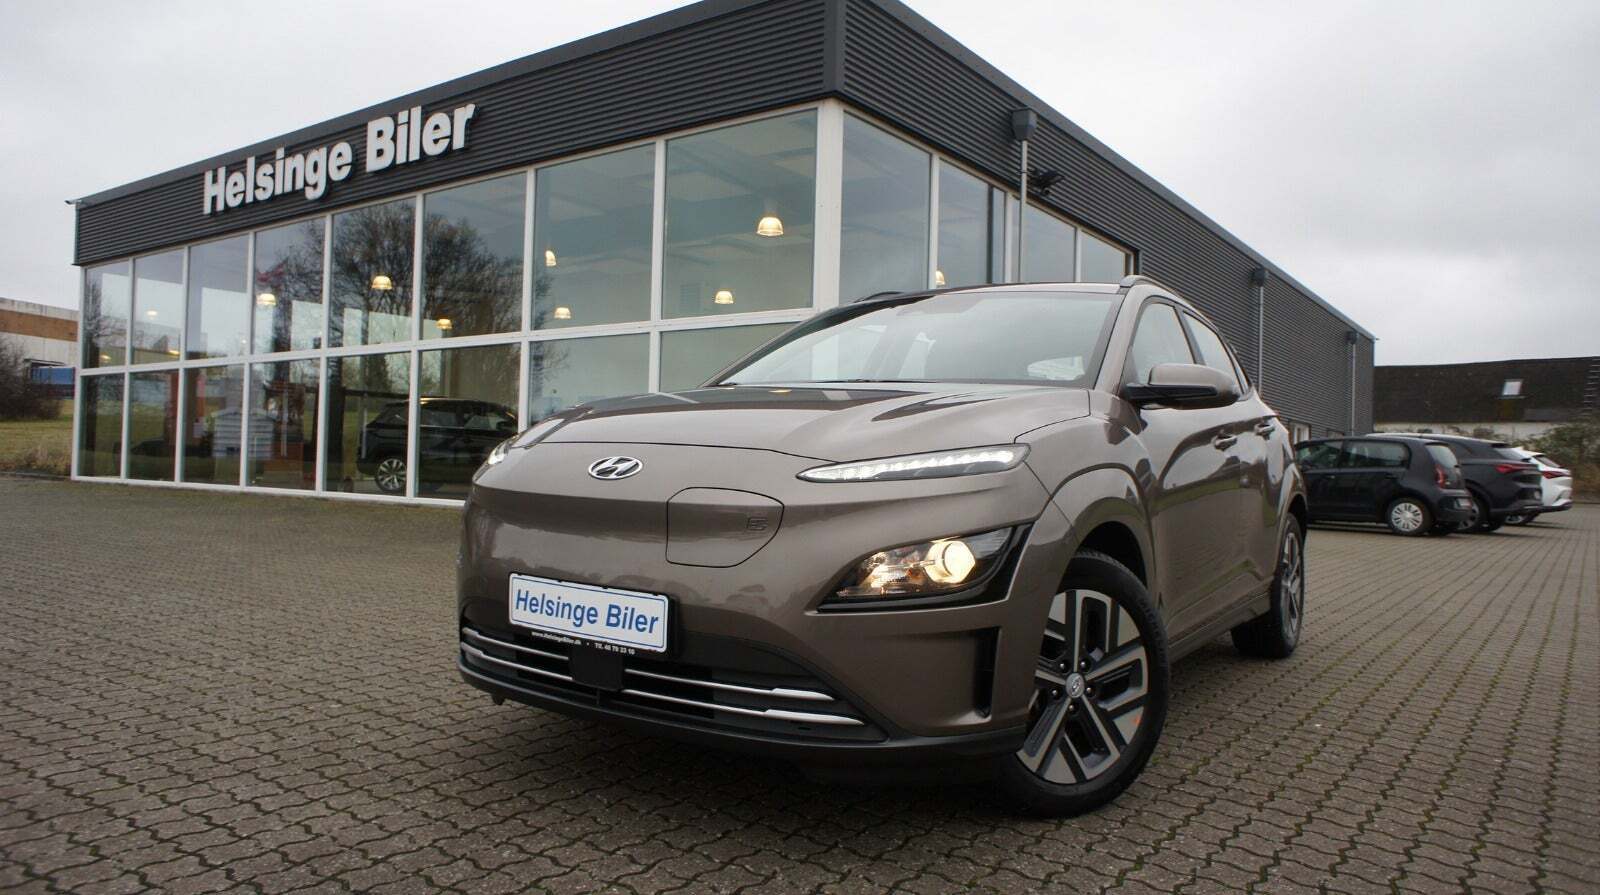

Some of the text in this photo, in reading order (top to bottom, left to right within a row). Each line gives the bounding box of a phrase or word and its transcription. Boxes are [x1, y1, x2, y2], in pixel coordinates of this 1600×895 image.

[203, 103, 476, 215] Helsinge Biler
[515, 589, 659, 633] Helsinge Biler
